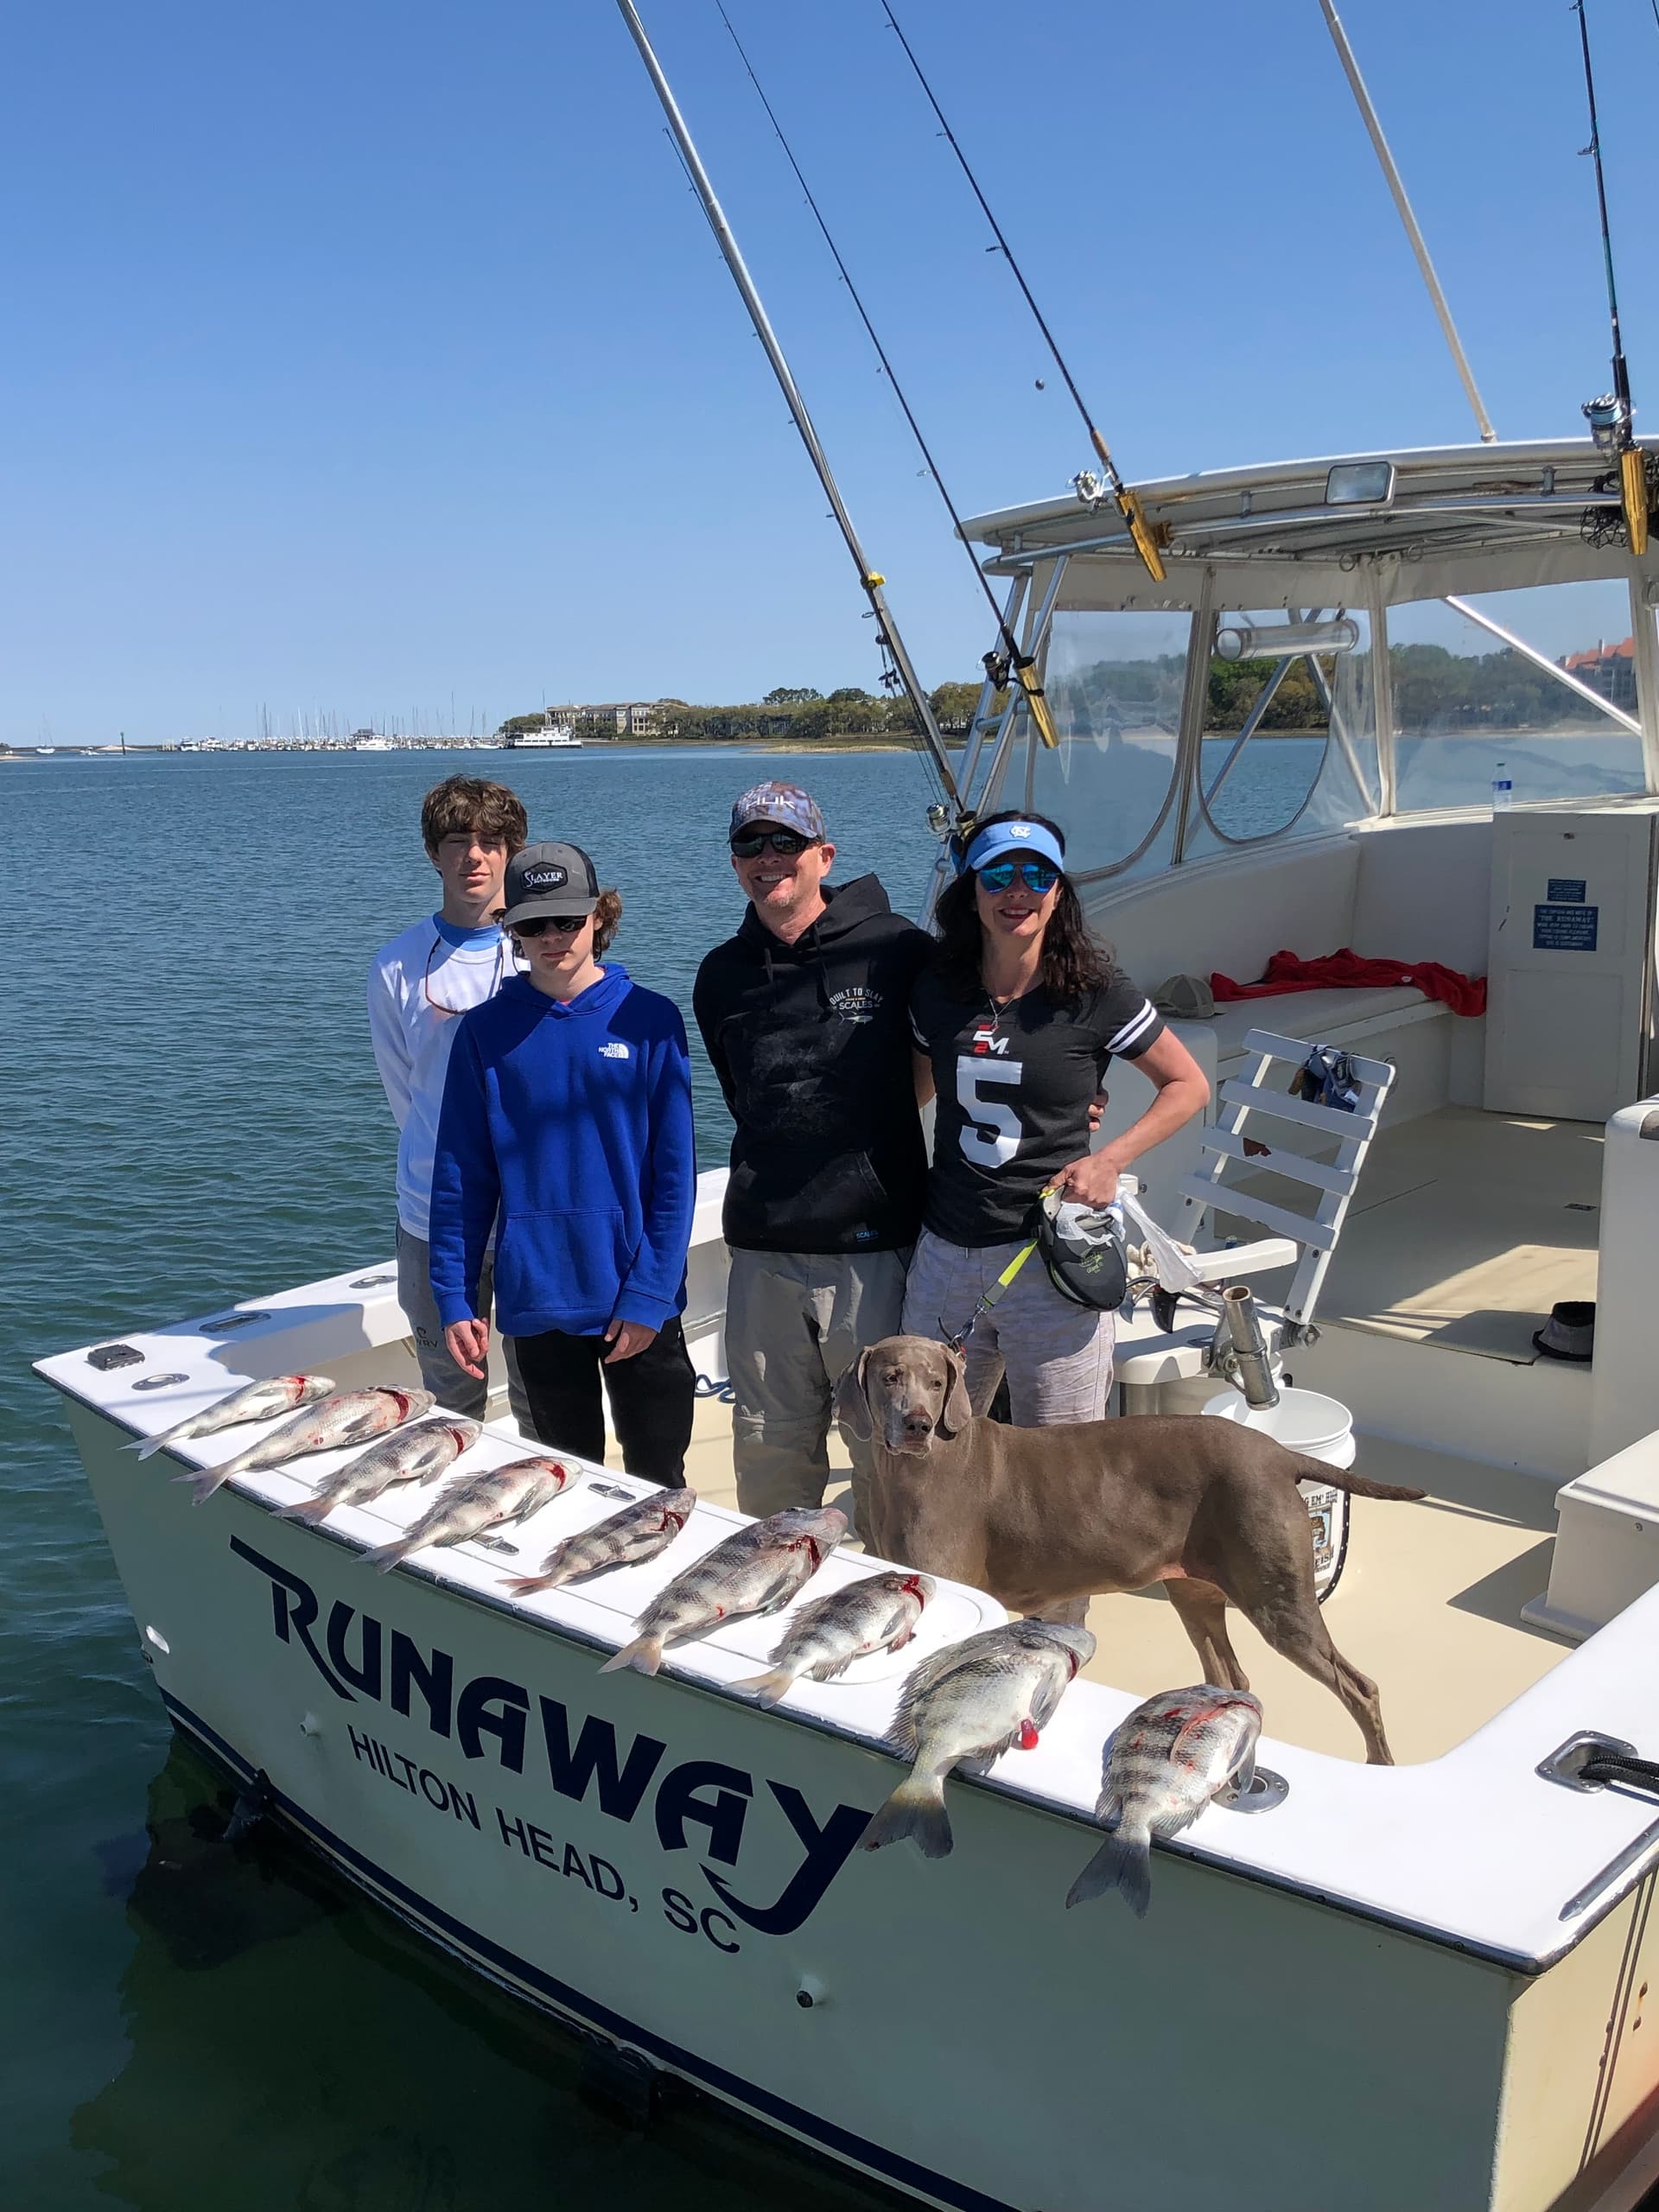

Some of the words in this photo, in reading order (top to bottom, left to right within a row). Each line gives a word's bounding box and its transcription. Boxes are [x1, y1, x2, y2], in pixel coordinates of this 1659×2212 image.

[524, 871, 563, 887] SLAYER
[829, 988, 850, 1005] BUILT
[853, 988, 863, 996] TO
[839, 1001, 873, 1010] SCALES
[956, 1055, 1023, 1169] 5
[230, 1534, 874, 1936] RUNAWAY
[347, 1724, 481, 1832] HILTON
[495, 1807, 639, 1913] HEAD,
[661, 1887, 741, 1954] SC
